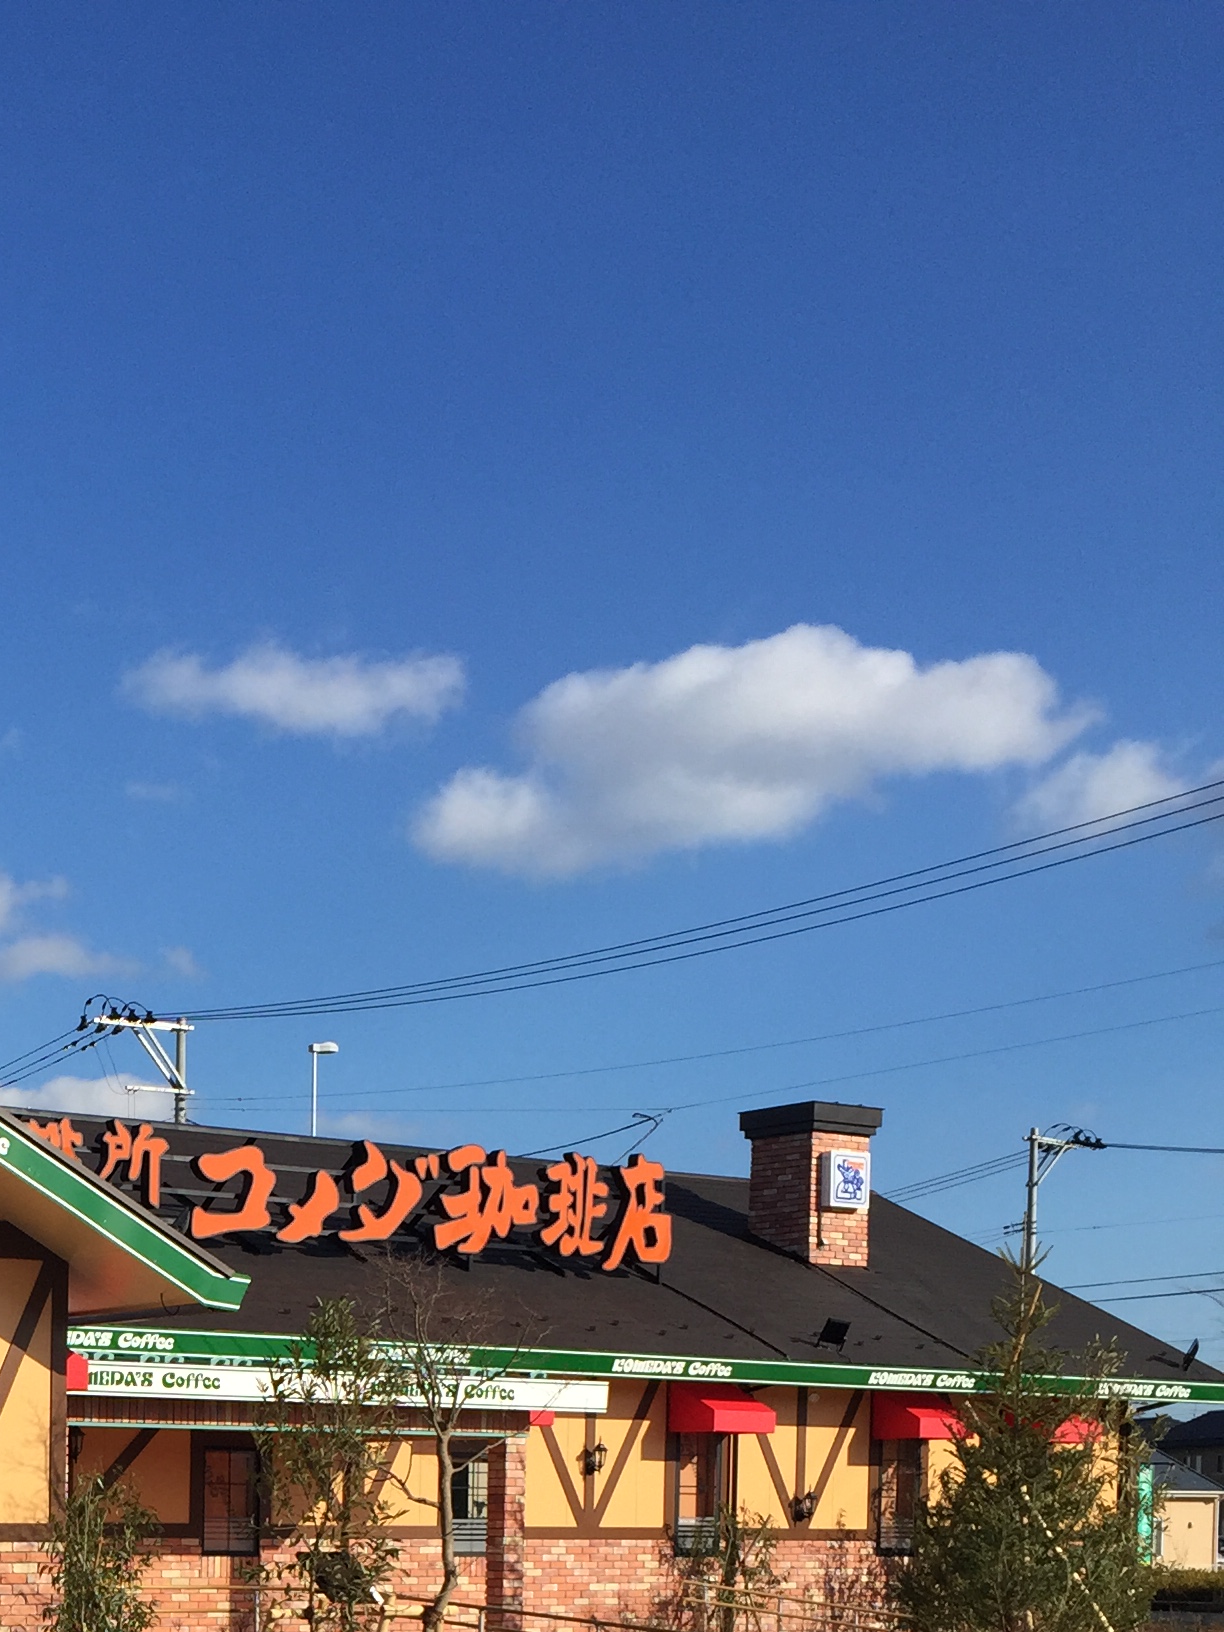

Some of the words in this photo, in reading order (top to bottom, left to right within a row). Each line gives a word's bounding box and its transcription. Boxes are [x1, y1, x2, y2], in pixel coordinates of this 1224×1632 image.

[118, 1332, 175, 1350] Coffee
[612, 1358, 686, 1375] KOMEDA'S
[688, 1361, 733, 1377] Coffee
[162, 1372, 221, 1390] Coffee
[868, 1371, 935, 1387] KOMEDA'S
[936, 1374, 976, 1389] Coffee
[464, 1383, 515, 1401] Coffee
[1156, 1384, 1191, 1398] Coffee
